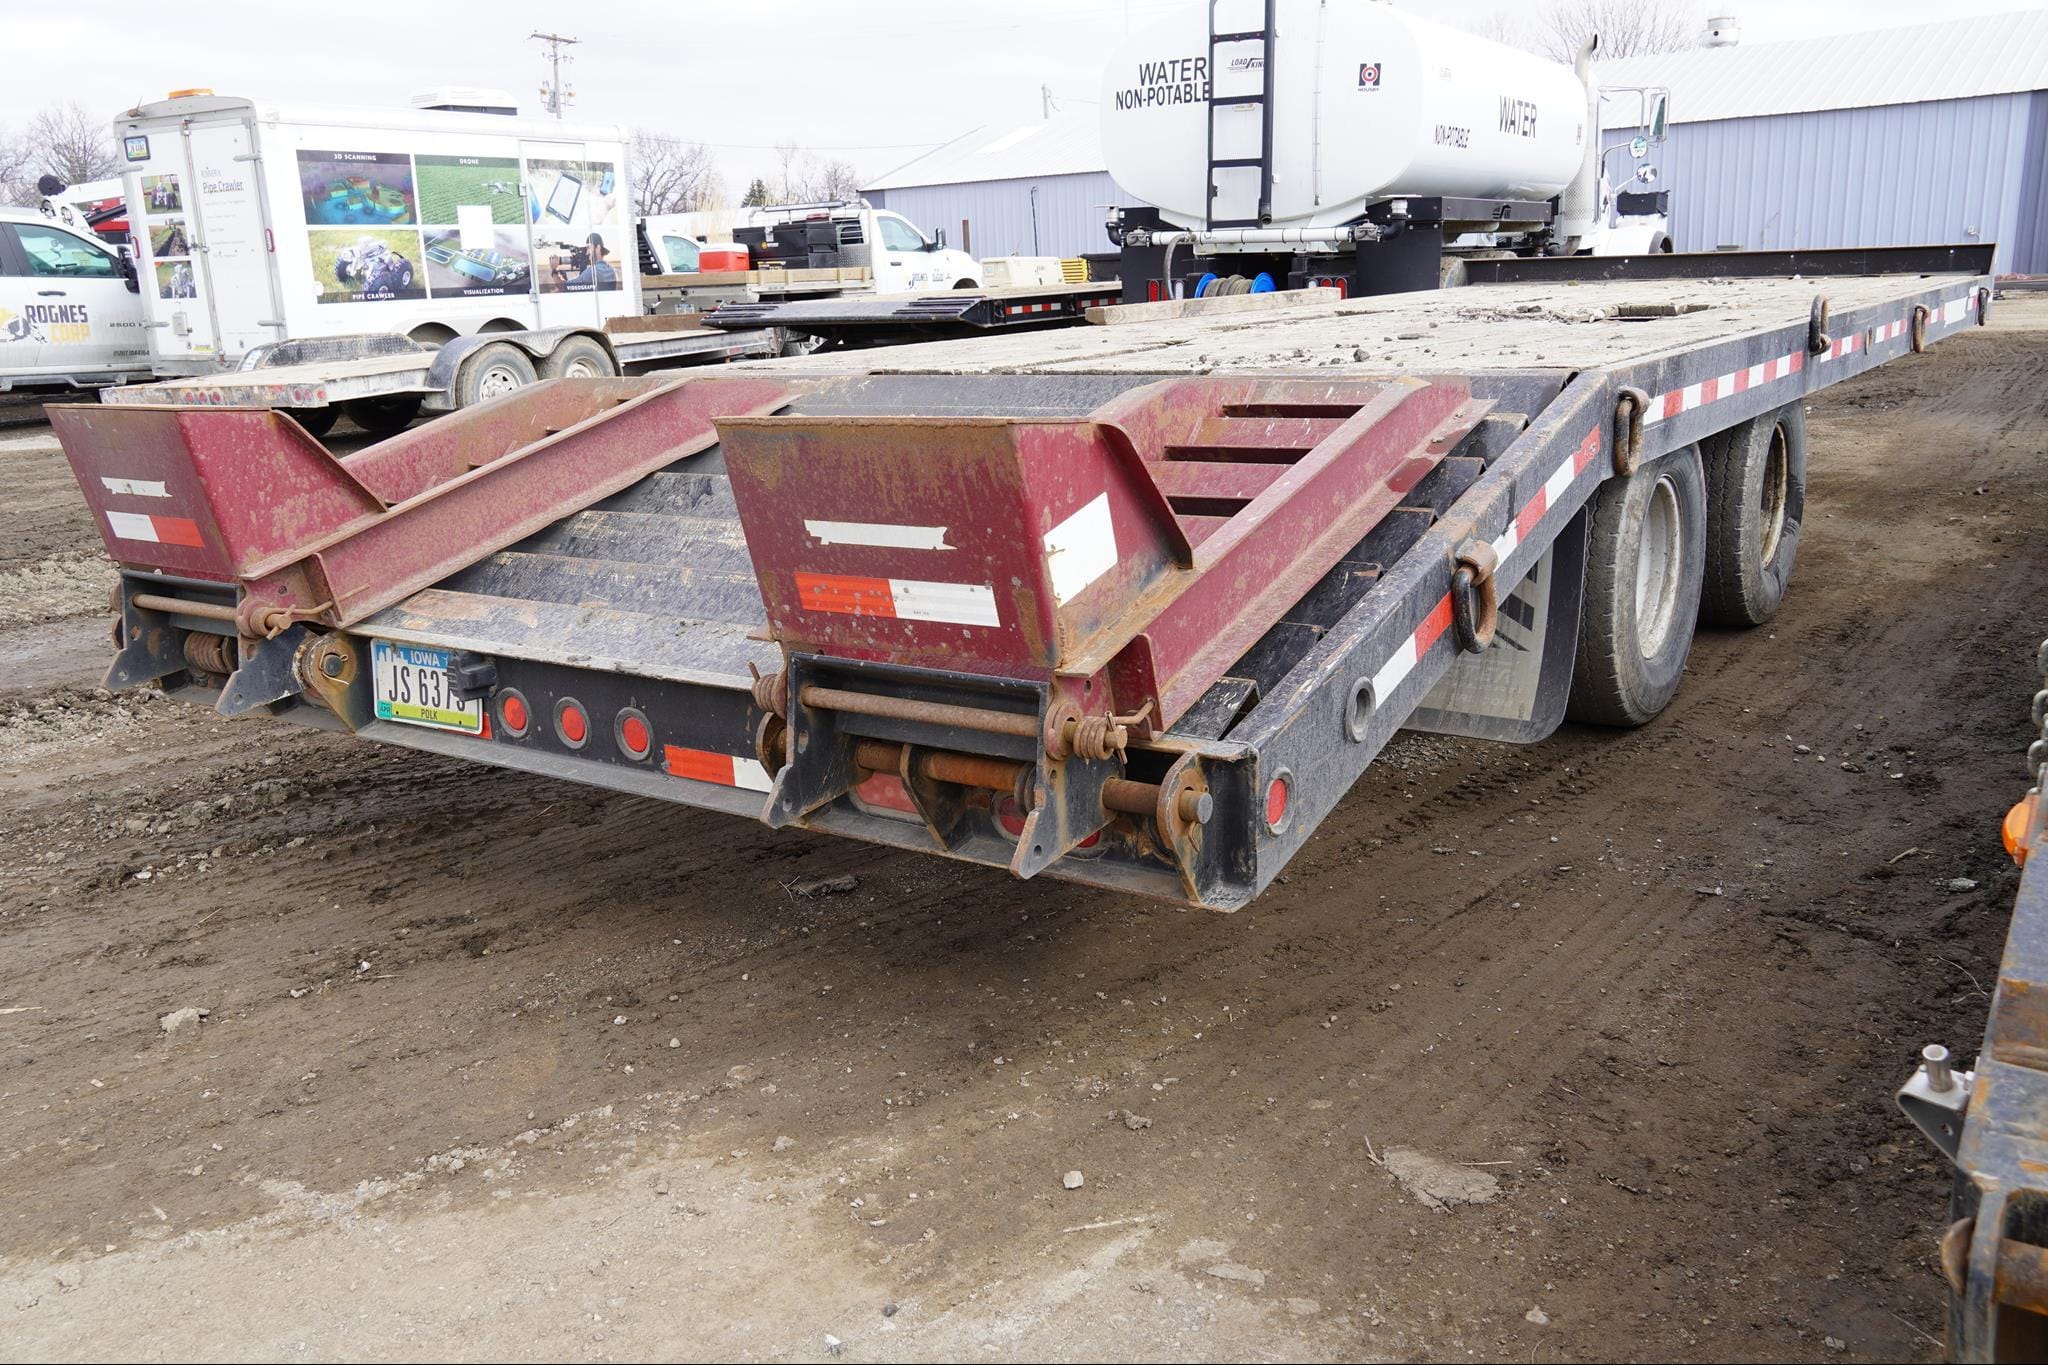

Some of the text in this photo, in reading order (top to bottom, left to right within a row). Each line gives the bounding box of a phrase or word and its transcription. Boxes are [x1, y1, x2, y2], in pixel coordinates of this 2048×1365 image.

[1139, 57, 1207, 86] WATER
[1231, 58, 1248, 66] LOAD
[1115, 82, 1210, 111] NON-POTABLE
[1498, 95, 1537, 139] WATER
[1434, 124, 1470, 149] NON-POTABLE
[202, 179, 244, 195] Pipe Crawler
[25, 304, 89, 324] ROGNES
[50, 324, 91, 343] CORP
[410, 652, 441, 667] IOWA
[388, 665, 466, 712] JS 637
[380, 705, 391, 714] APR
[421, 709, 438, 721] POLK
